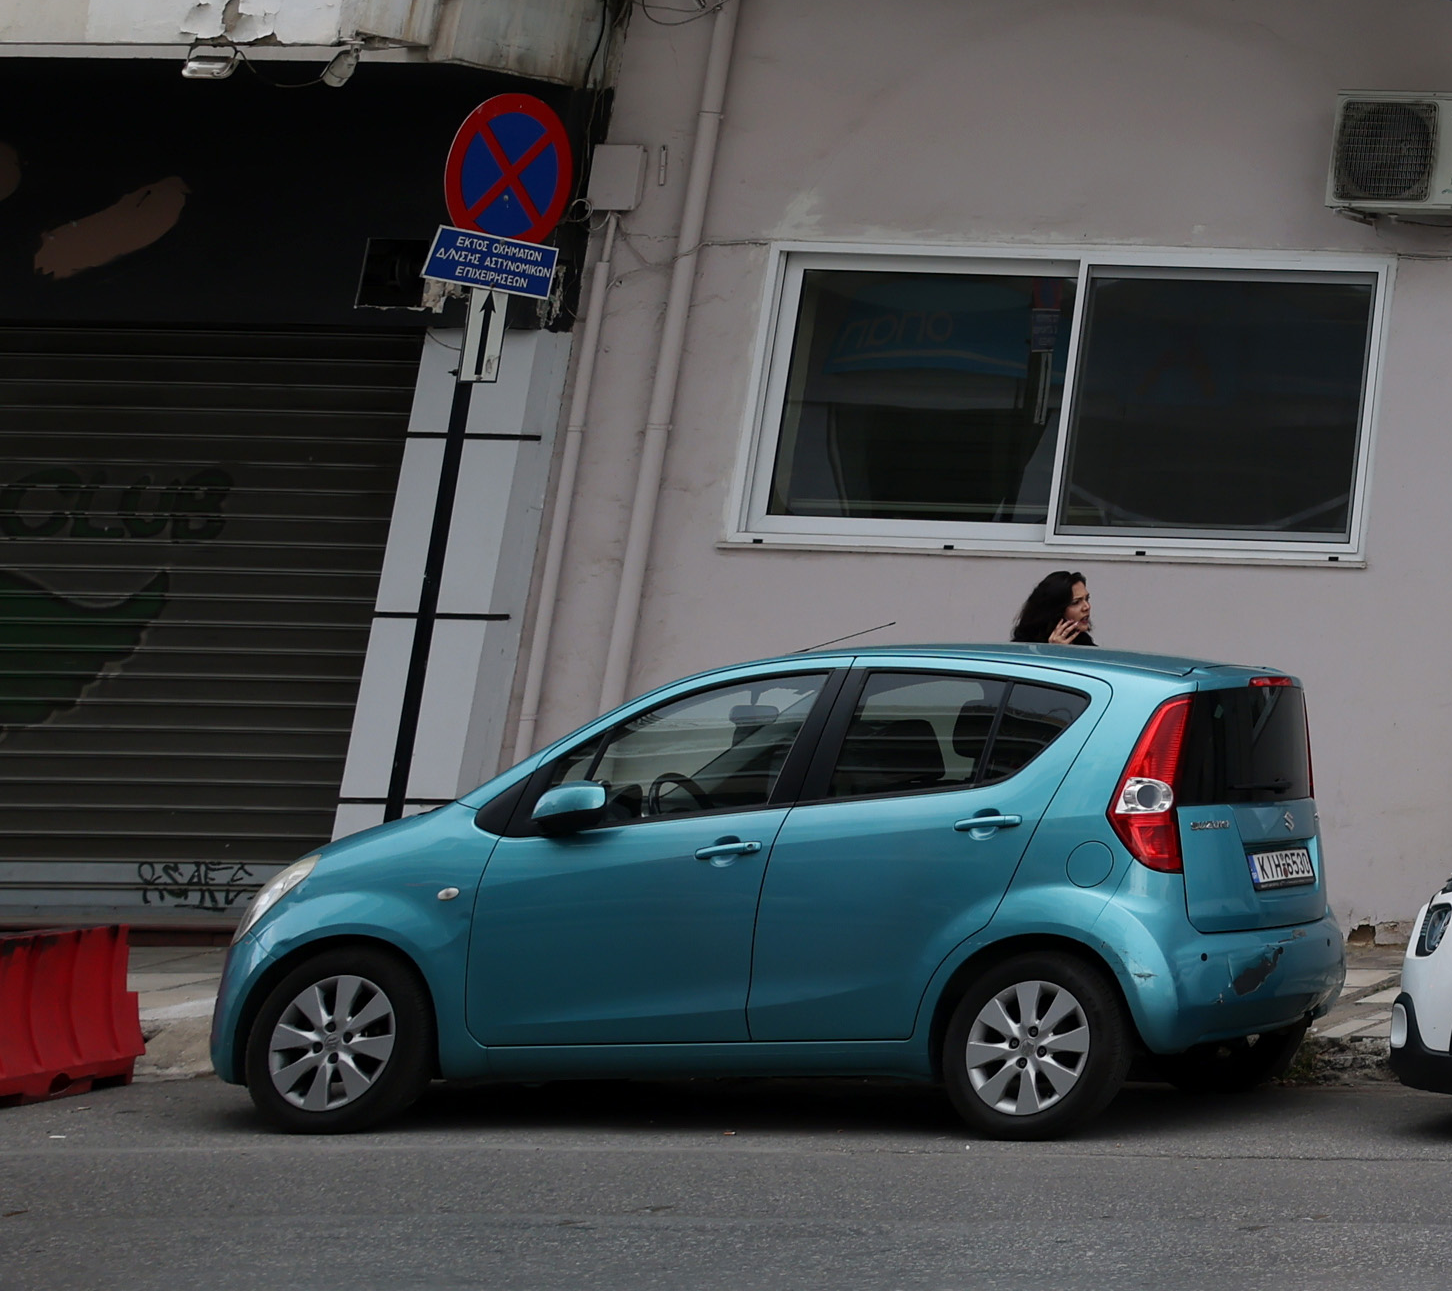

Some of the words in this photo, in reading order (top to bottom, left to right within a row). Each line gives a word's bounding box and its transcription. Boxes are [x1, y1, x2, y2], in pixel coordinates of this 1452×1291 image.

[456, 236, 489, 251] ΕΚΤΟΣ
[492, 243, 543, 262] ΟΧΗΜΑΤΩΝ
[436, 247, 481, 265] Δ/ΝΣΗΣ
[484, 257, 551, 278] ΑΣΤΥΝΟΜΙΚΩΝ
[455, 266, 528, 288] ΕΠΙΧΕΙΡΗΣΕΩΝ
